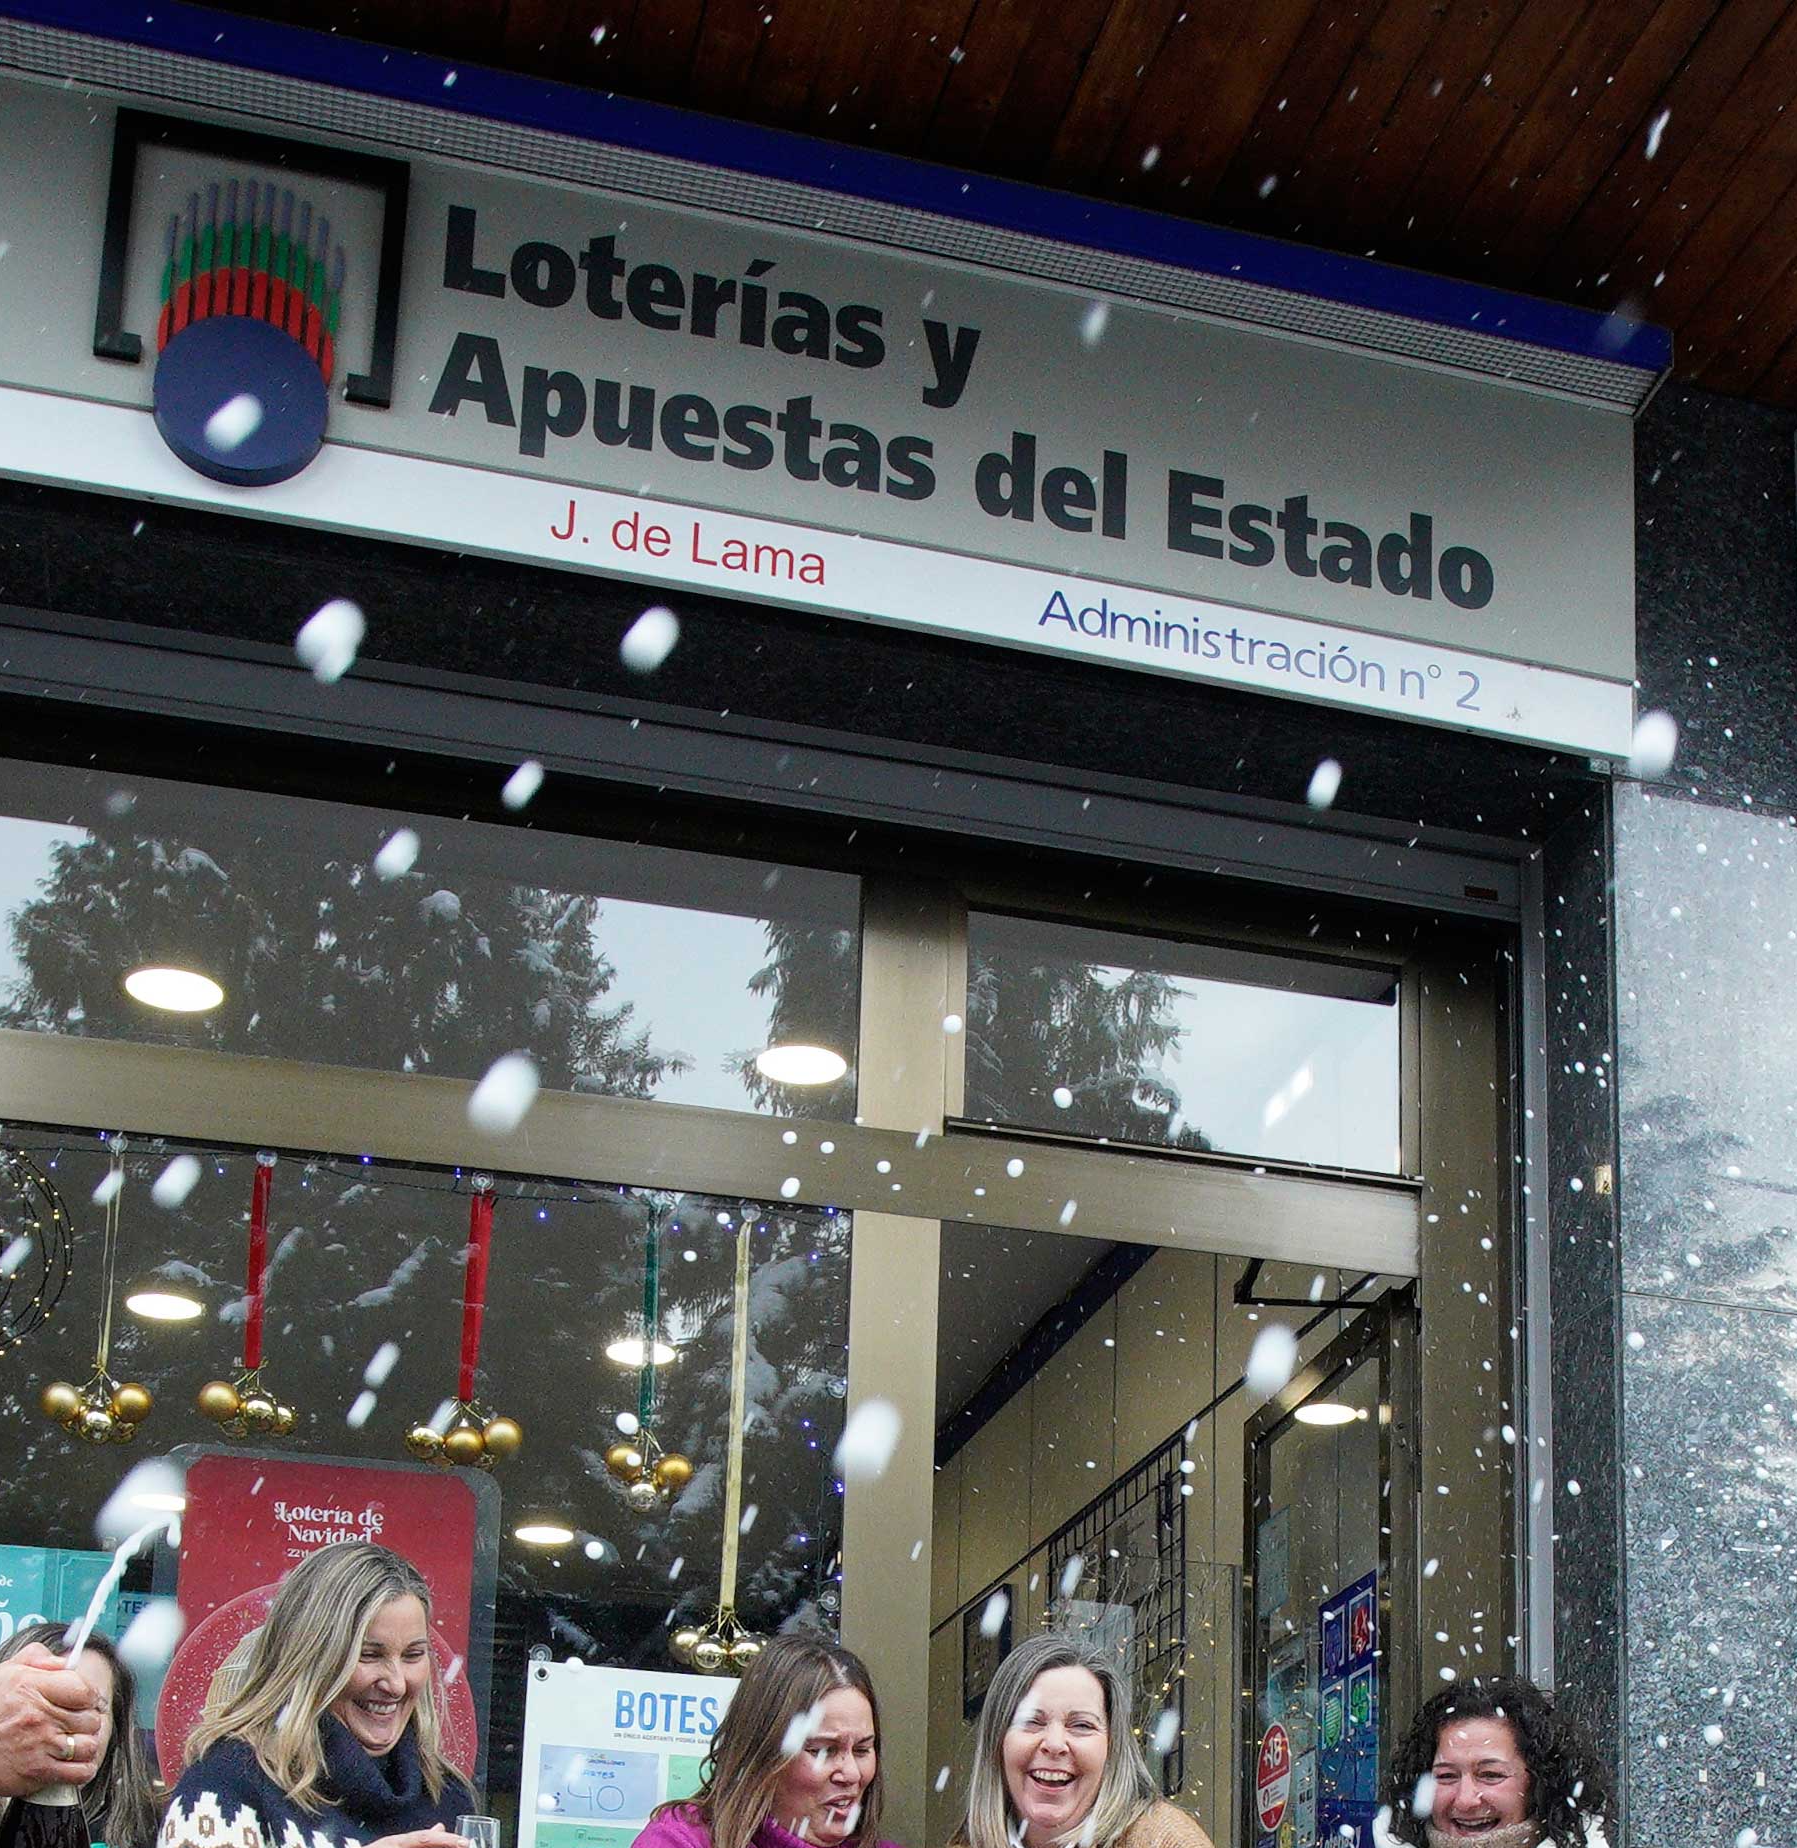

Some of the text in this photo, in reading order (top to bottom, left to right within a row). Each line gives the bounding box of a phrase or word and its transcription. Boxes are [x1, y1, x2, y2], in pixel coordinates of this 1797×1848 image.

[443, 205, 982, 409] Loterías y
[428, 331, 1495, 610] Apuestas del Estado
[550, 500, 826, 586] J. de Lama
[1037, 589, 1386, 692] Administración
[1455, 670, 1482, 712] 2
[274, 1501, 385, 1527] Lotería de
[287, 1523, 383, 1544] Navidad
[0, 1575, 14, 1587] de
[614, 1690, 719, 1735] BOTES
